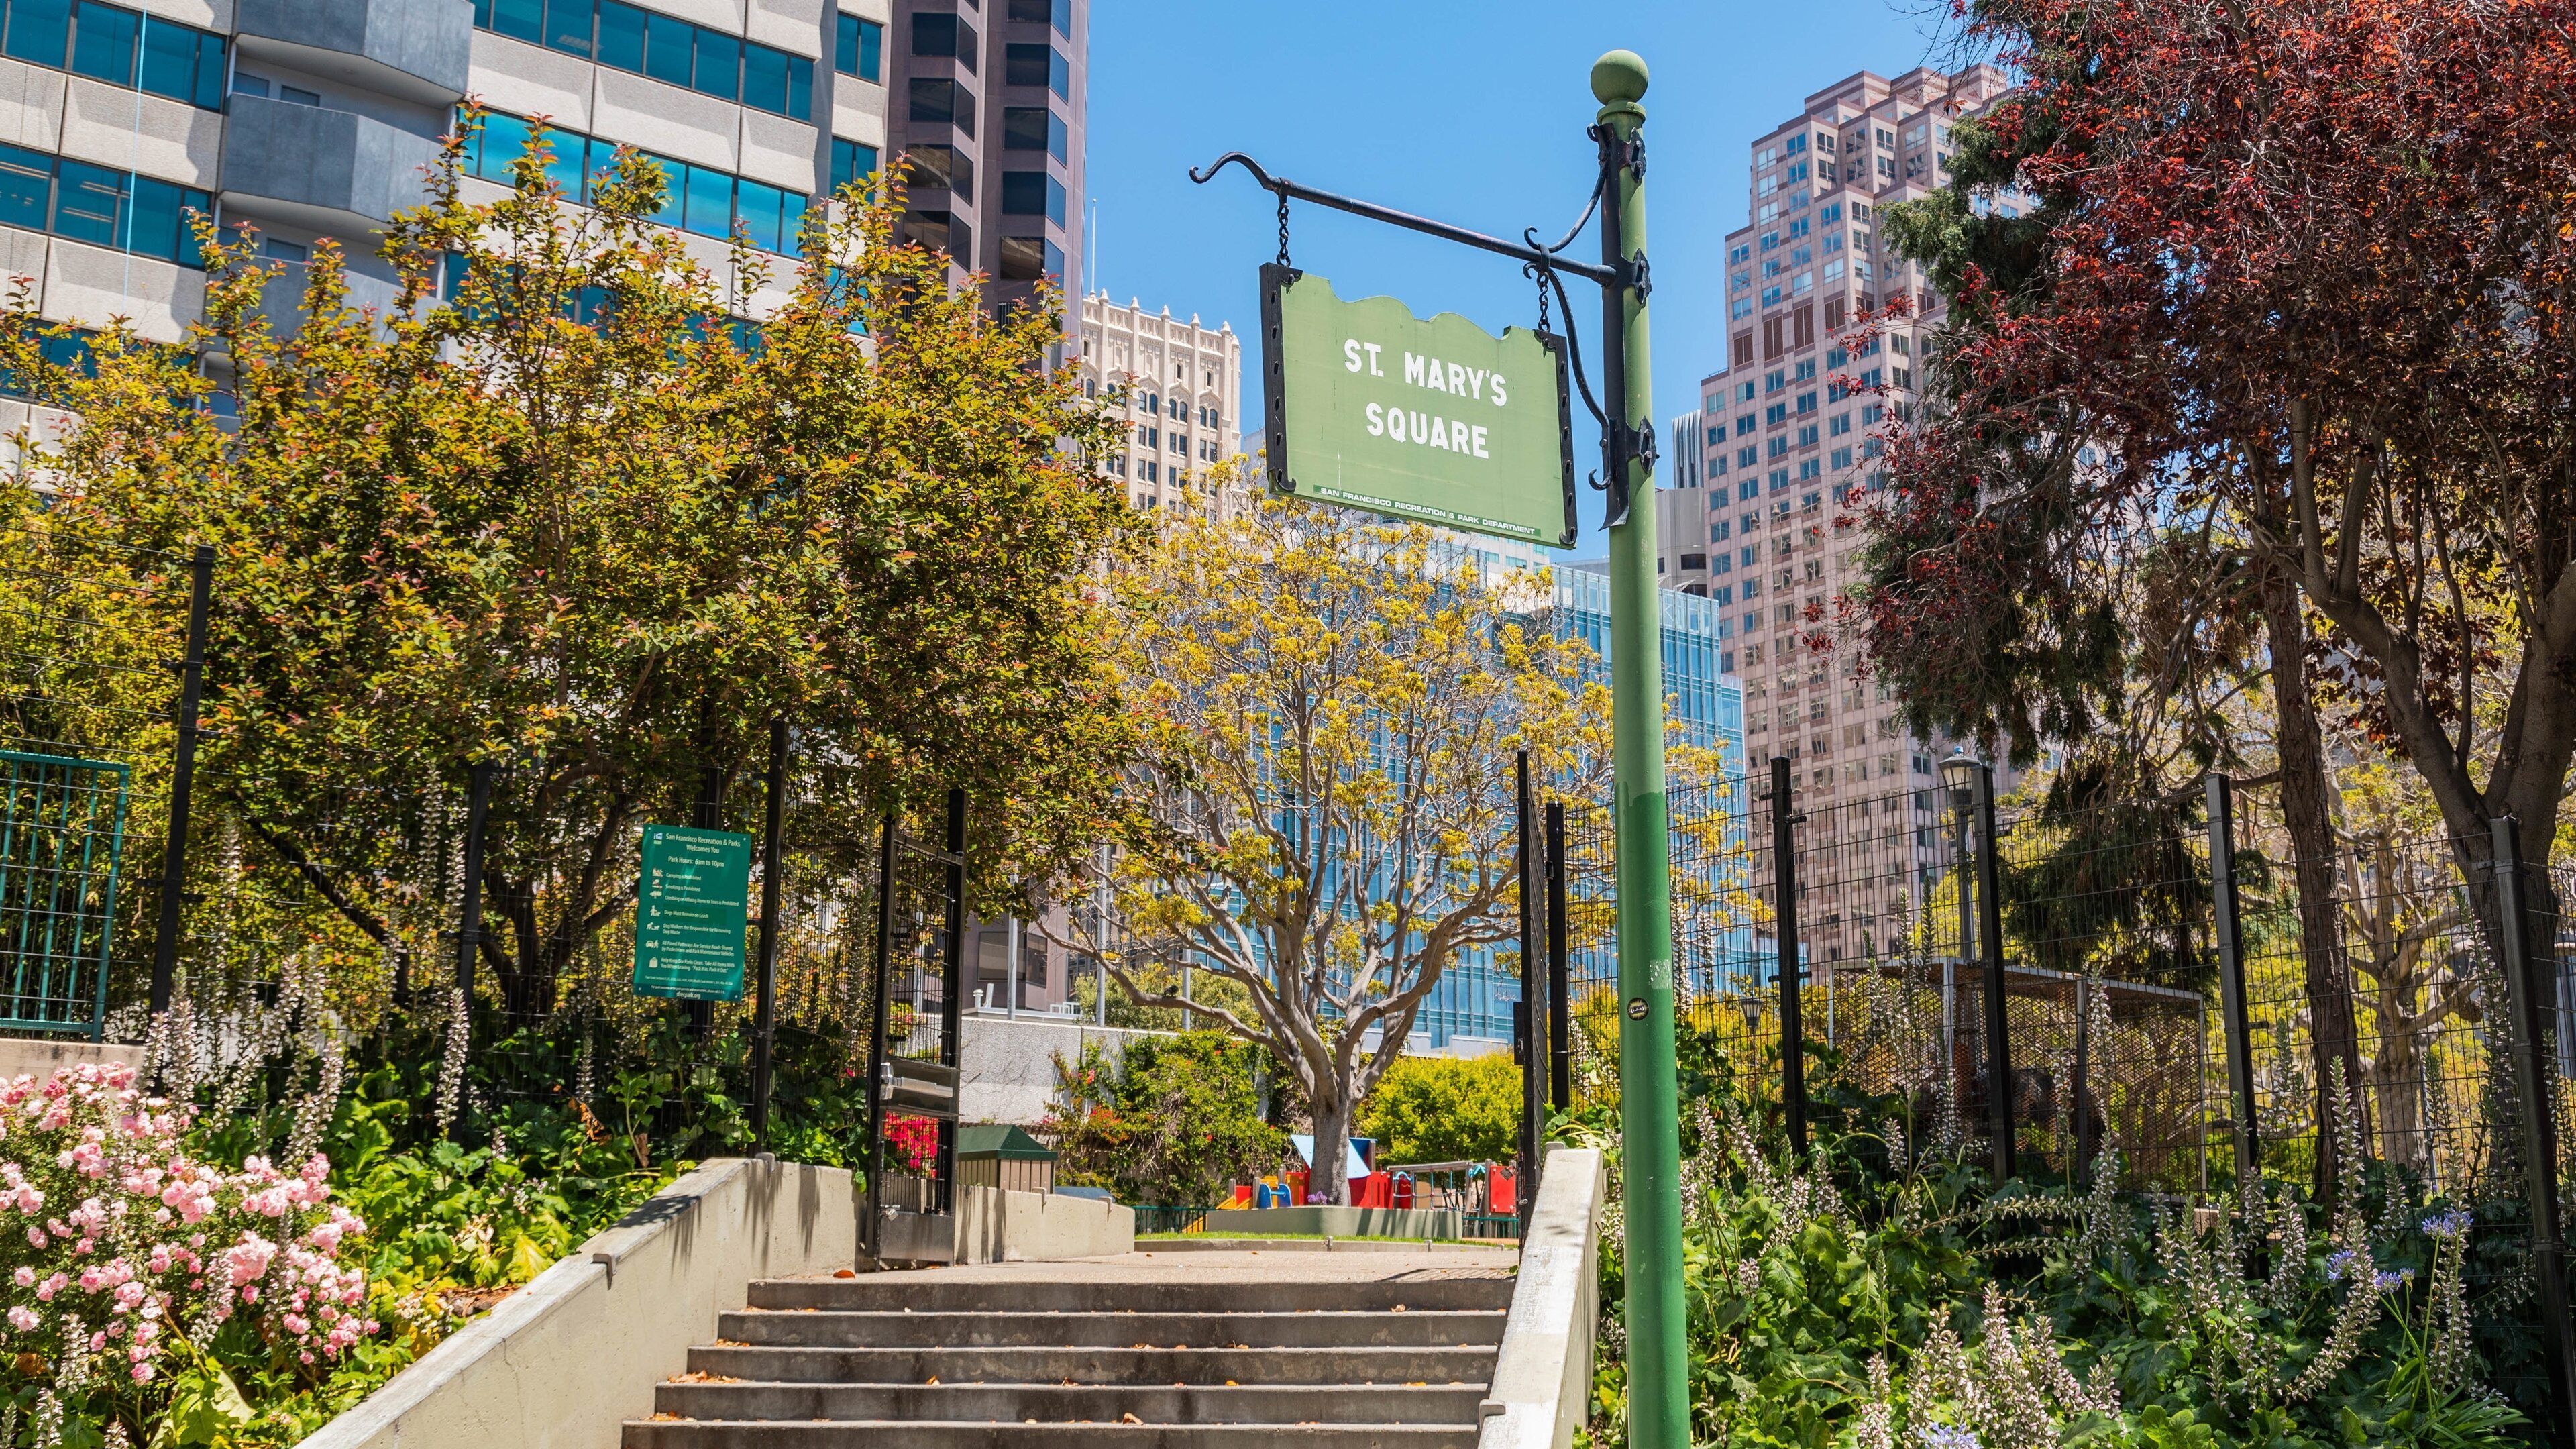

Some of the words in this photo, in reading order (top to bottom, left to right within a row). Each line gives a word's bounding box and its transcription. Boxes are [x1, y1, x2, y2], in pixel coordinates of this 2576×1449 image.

[1344, 338, 1384, 378] ST.
[1405, 351, 1507, 407] MARY'S
[1366, 402, 1489, 459] SQUARE
[1320, 488, 1340, 497] SAN
[1342, 492, 1392, 507] FRANCISCO
[1395, 502, 1446, 517] RECREATION
[1458, 514, 1479, 524] PARK
[1482, 518, 1536, 535] DEPARTMENT
[665, 833, 676, 841] San
[676, 834, 698, 843] Francisco
[698, 836, 722, 845] Recreation
[728, 839, 741, 847] Parks
[686, 844, 710, 853] Welcomes
[710, 846, 720, 854] You
[678, 857, 694, 865] Hours:
[711, 860, 724, 868] 10pm
